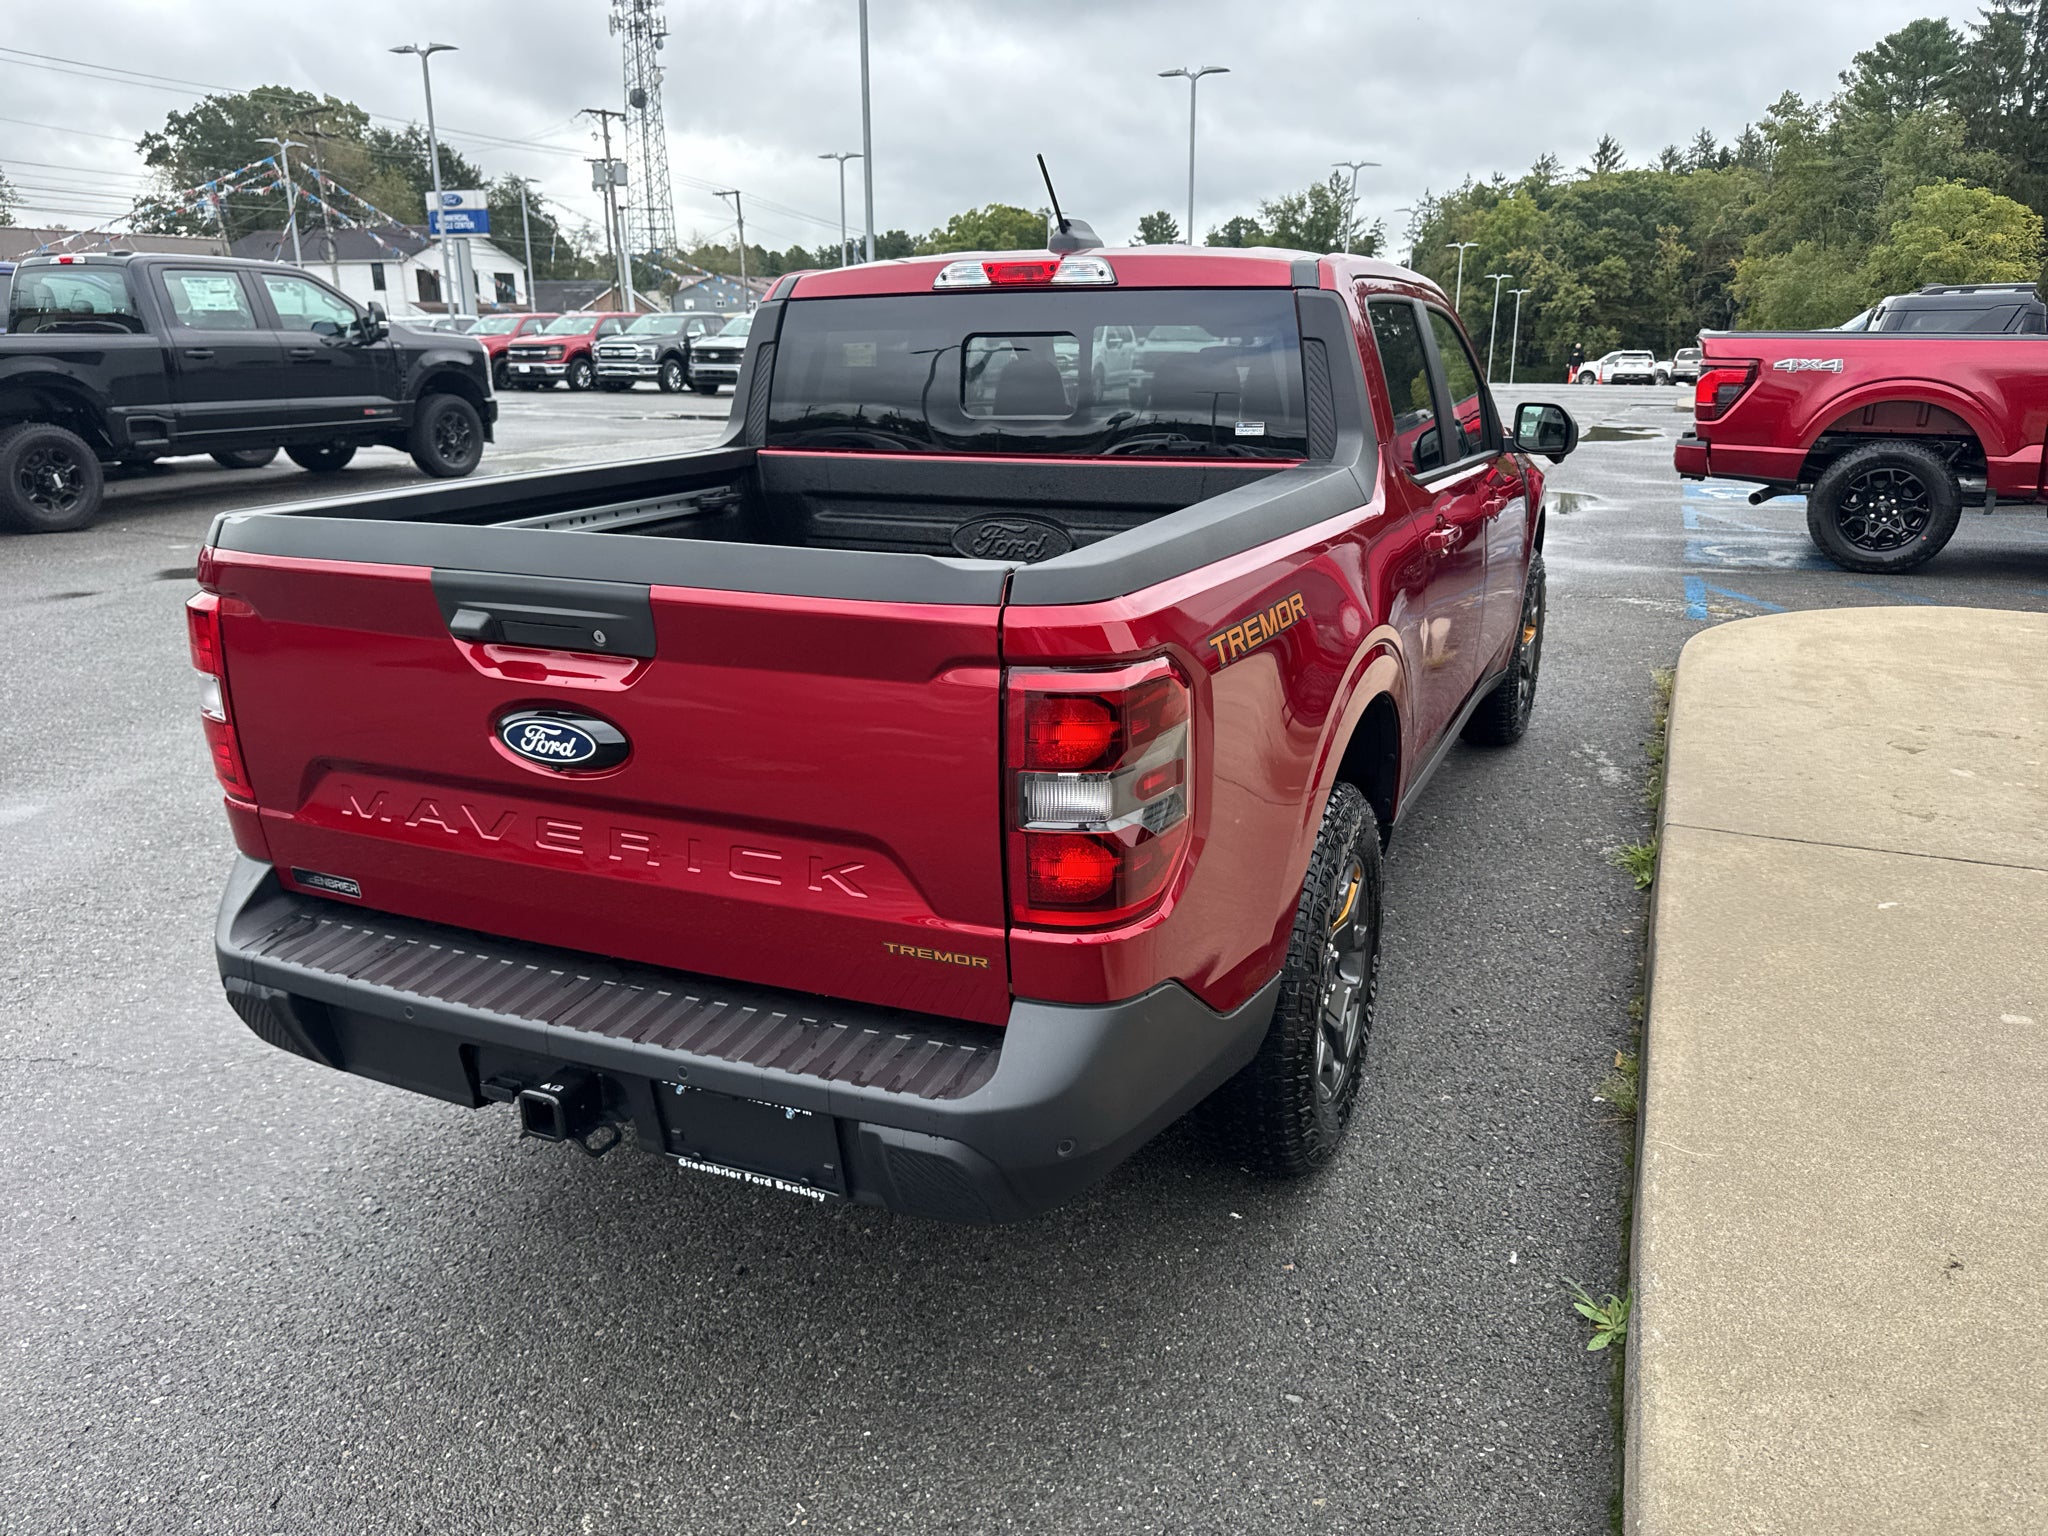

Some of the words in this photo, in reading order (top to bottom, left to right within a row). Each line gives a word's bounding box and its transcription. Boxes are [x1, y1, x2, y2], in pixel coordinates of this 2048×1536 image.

[972, 522, 1048, 559] Ford
[1209, 592, 1308, 665] TREMOR
[520, 725, 577, 757] Ford
[339, 784, 870, 900] MAVERICK
[883, 942, 990, 969] TREMOR
[678, 1157, 742, 1180] Greenbrier
[744, 1173, 772, 1188] Ford
[775, 1180, 826, 1202] Beckley
